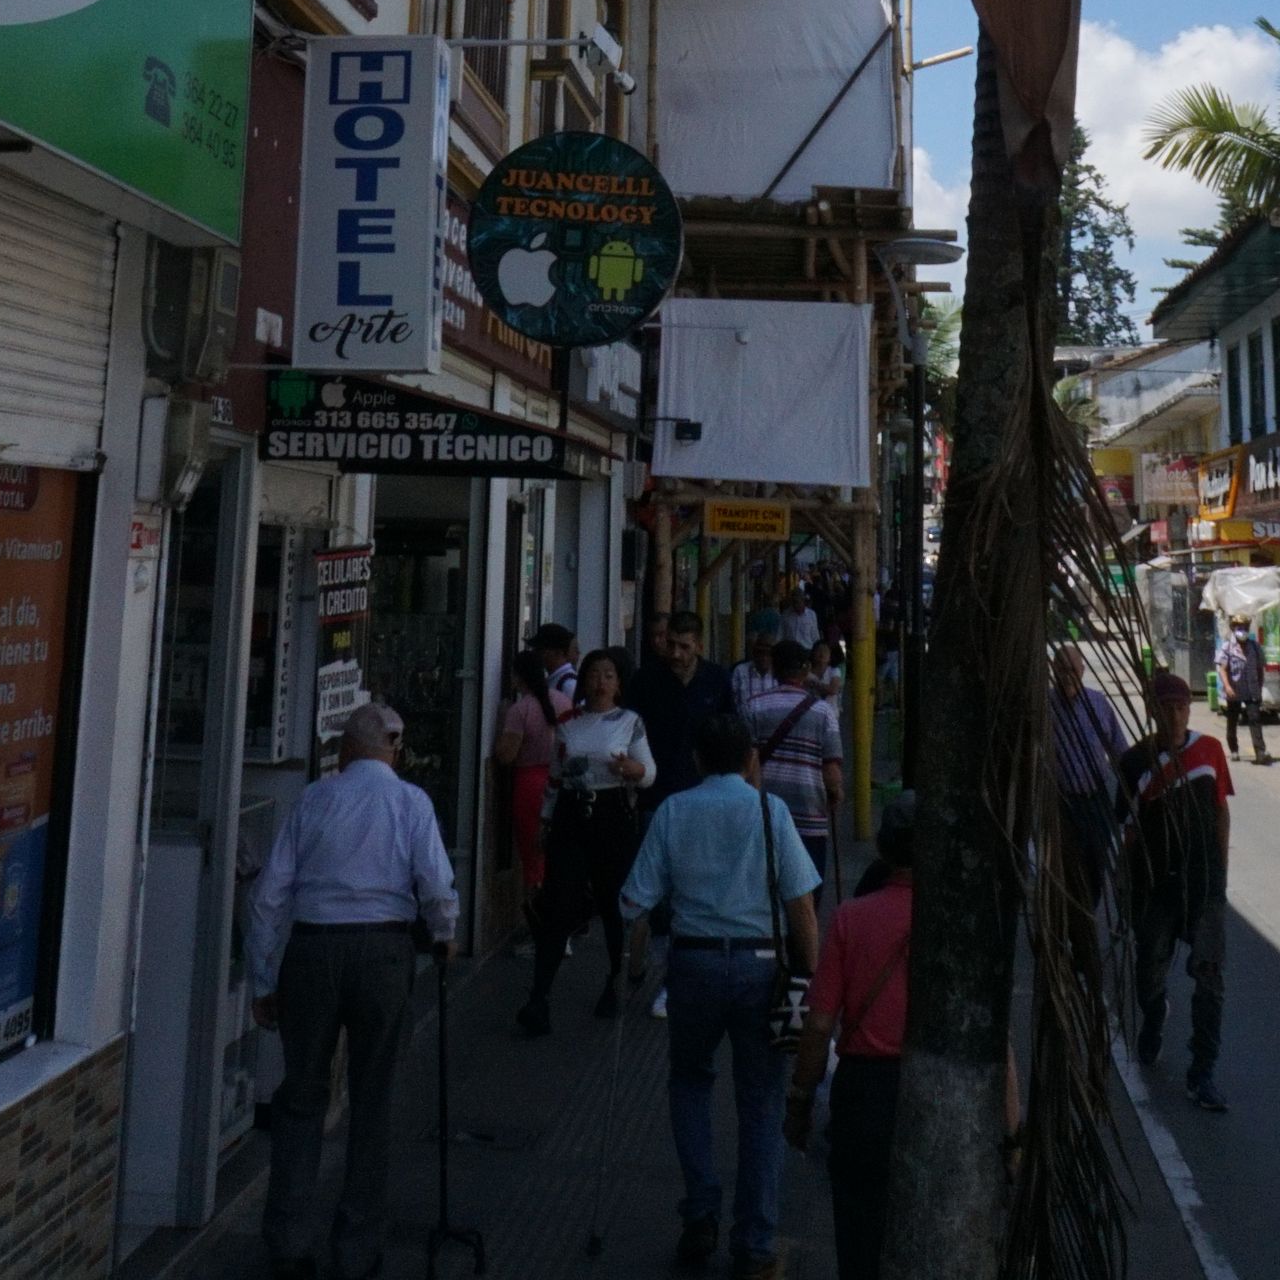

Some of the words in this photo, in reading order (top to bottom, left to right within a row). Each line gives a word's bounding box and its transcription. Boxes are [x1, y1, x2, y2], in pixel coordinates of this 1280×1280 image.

[329, 50, 412, 306] HOTEL
[501, 168, 657, 197] JUANCELLL
[496, 196, 658, 225] TECNOLOGY
[308, 310, 414, 361] Arte
[351, 388, 397, 409] Apple
[313, 409, 355, 430] 313
[356, 410, 401, 431] 665
[403, 411, 459, 433] 3547
[267, 431, 413, 460] SERVICIO
[418, 430, 555, 463] TÉCNICO
[5, 537, 52, 561] Vitamina
[52, 539, 63, 561] D
[283, 524, 297, 631] SERVICIO
[318, 556, 371, 587] CELULARES
[0, 597, 14, 627] al
[16, 595, 41, 628] día,
[326, 586, 369, 616] CREDITO
[34, 638, 49, 663] tu
